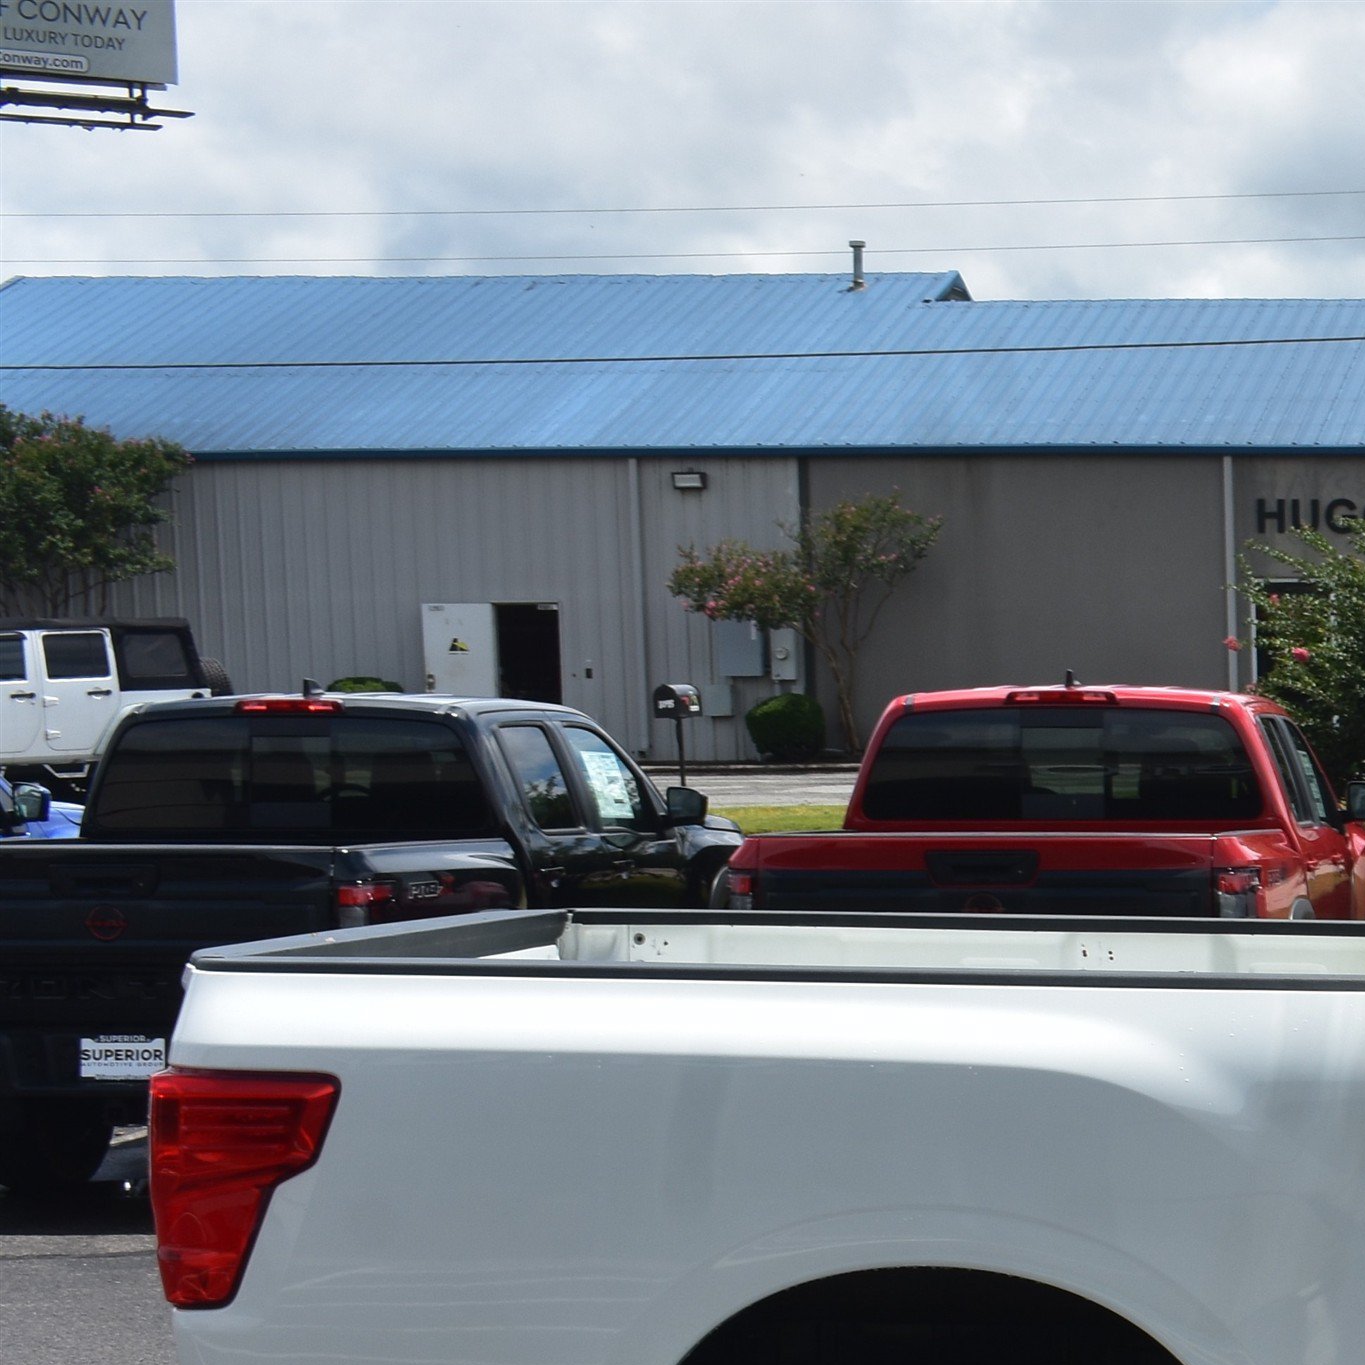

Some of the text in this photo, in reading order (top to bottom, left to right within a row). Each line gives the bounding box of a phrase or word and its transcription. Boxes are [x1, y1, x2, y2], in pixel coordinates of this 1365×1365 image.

[18, 0, 147, 31] CONWAY
[4, 27, 126, 50] LUXURY TODAY
[0, 51, 84, 69] onway.com
[81, 1049, 163, 1061] SUPERIOR
